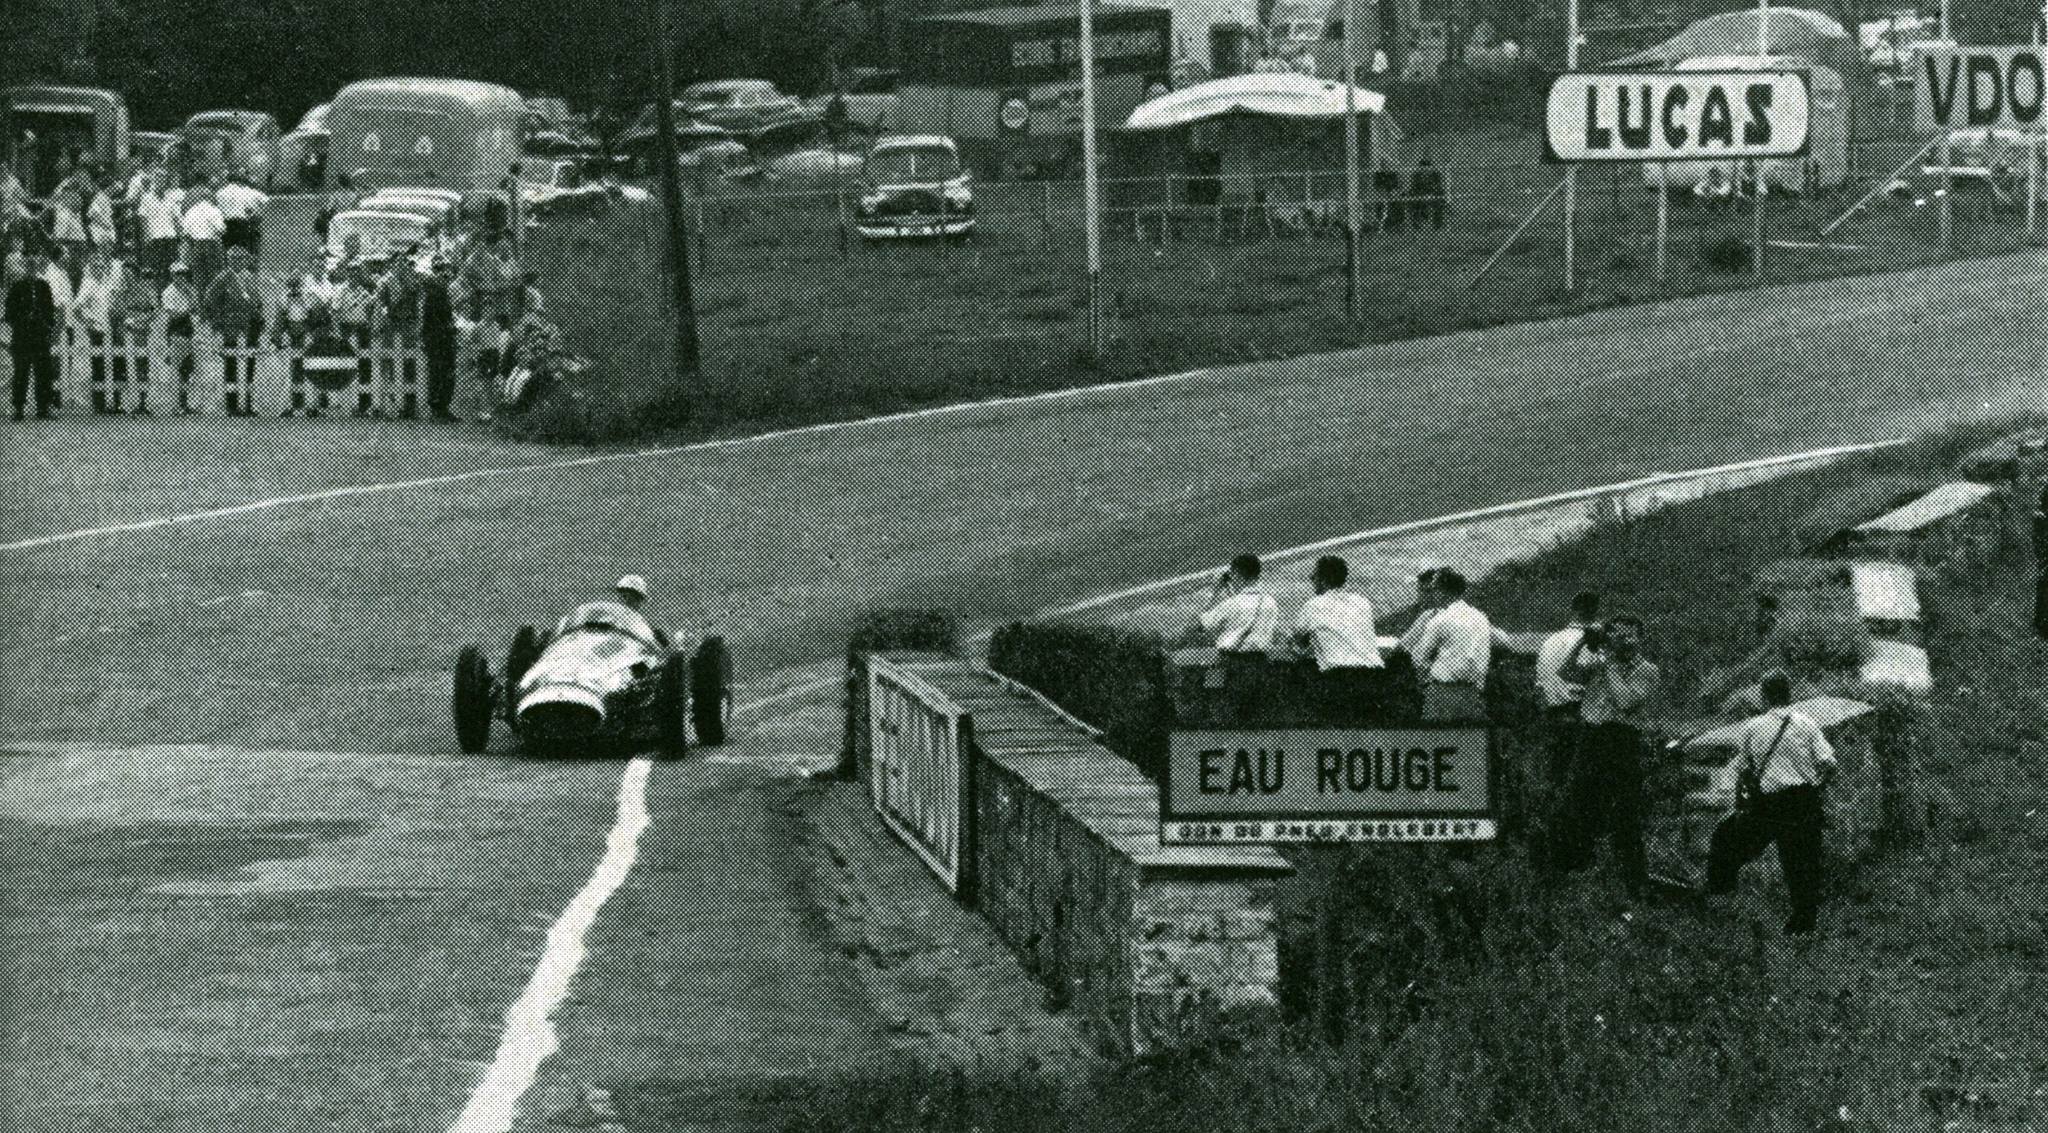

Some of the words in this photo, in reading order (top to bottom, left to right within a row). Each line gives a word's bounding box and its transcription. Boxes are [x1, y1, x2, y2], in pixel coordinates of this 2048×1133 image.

[1586, 84, 1773, 149] LUCAS
[1925, 53, 2044, 125] VDO
[1199, 749, 1284, 795] EAU
[1317, 748, 1459, 793] ROUGE
